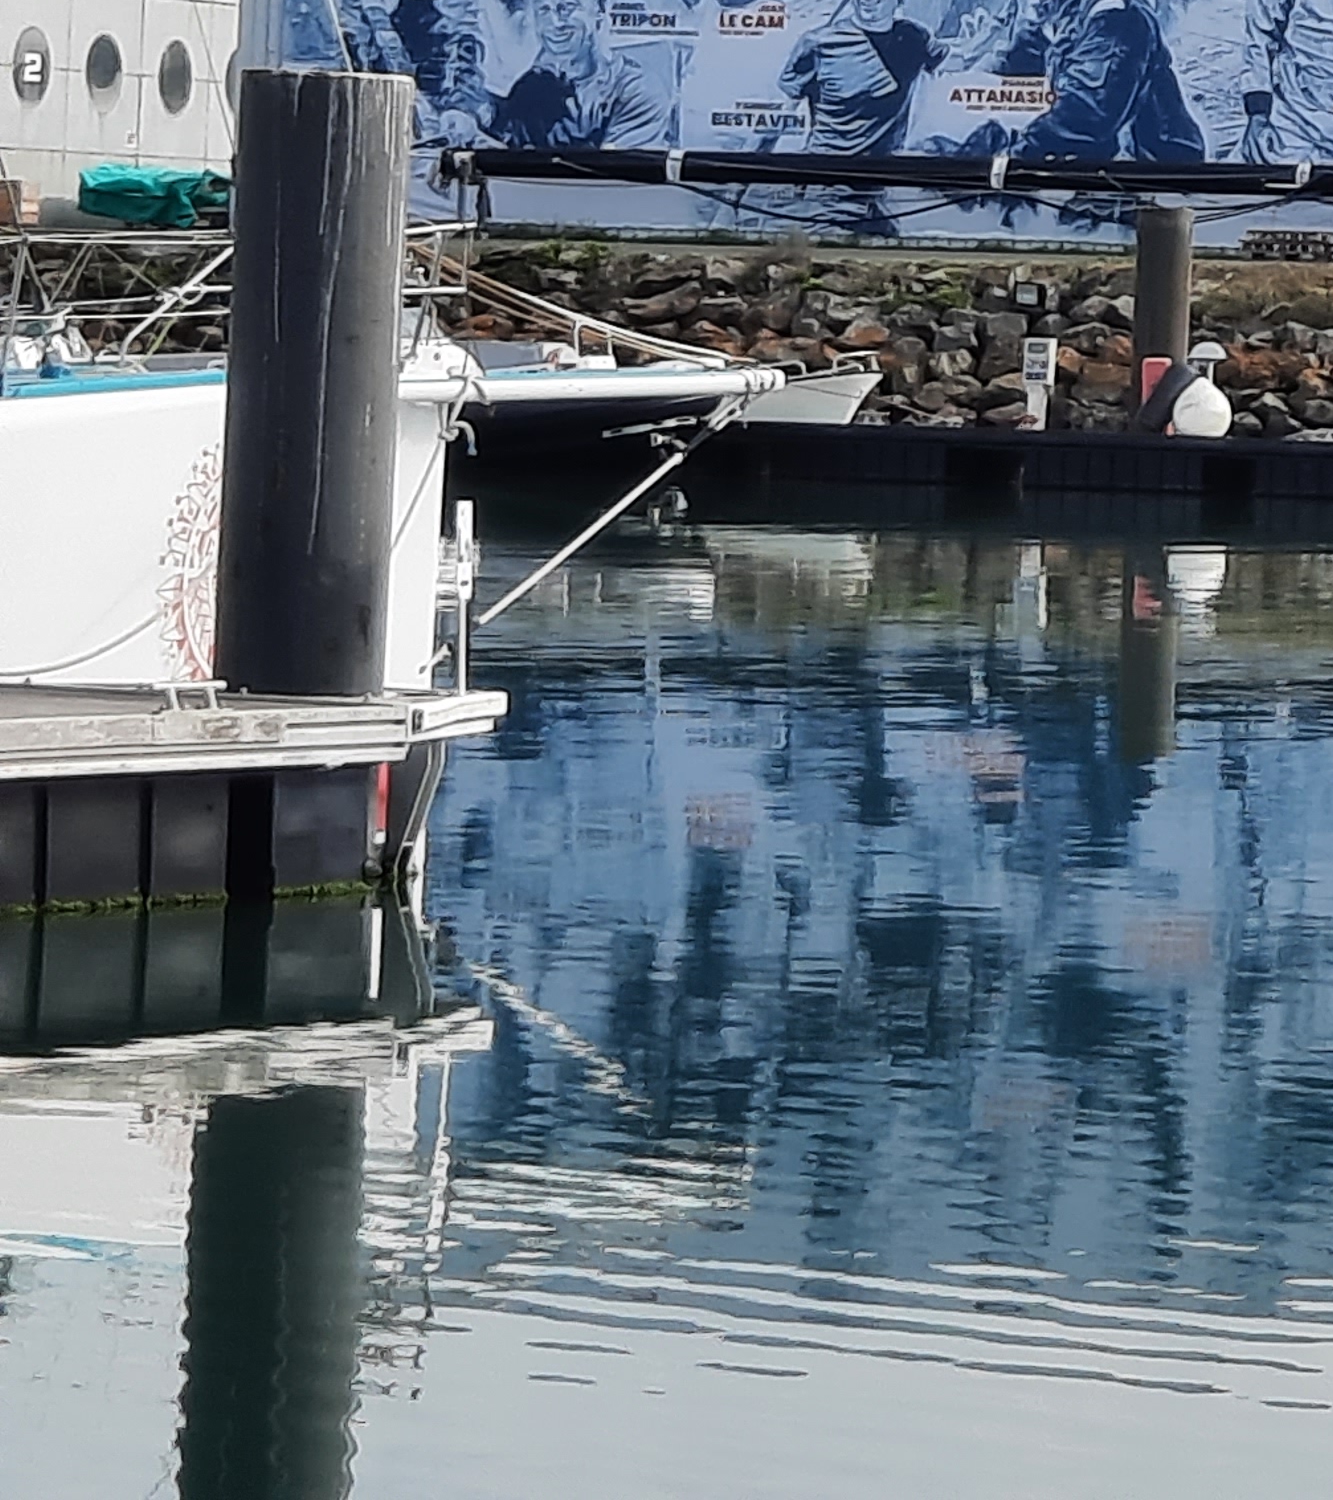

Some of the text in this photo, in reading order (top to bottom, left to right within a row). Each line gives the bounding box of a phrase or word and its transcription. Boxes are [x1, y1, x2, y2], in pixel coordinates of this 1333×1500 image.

[609, 12, 676, 28] TRIPON
[23, 52, 42, 82] 2
[950, 88, 1058, 105] ATTANASIO
